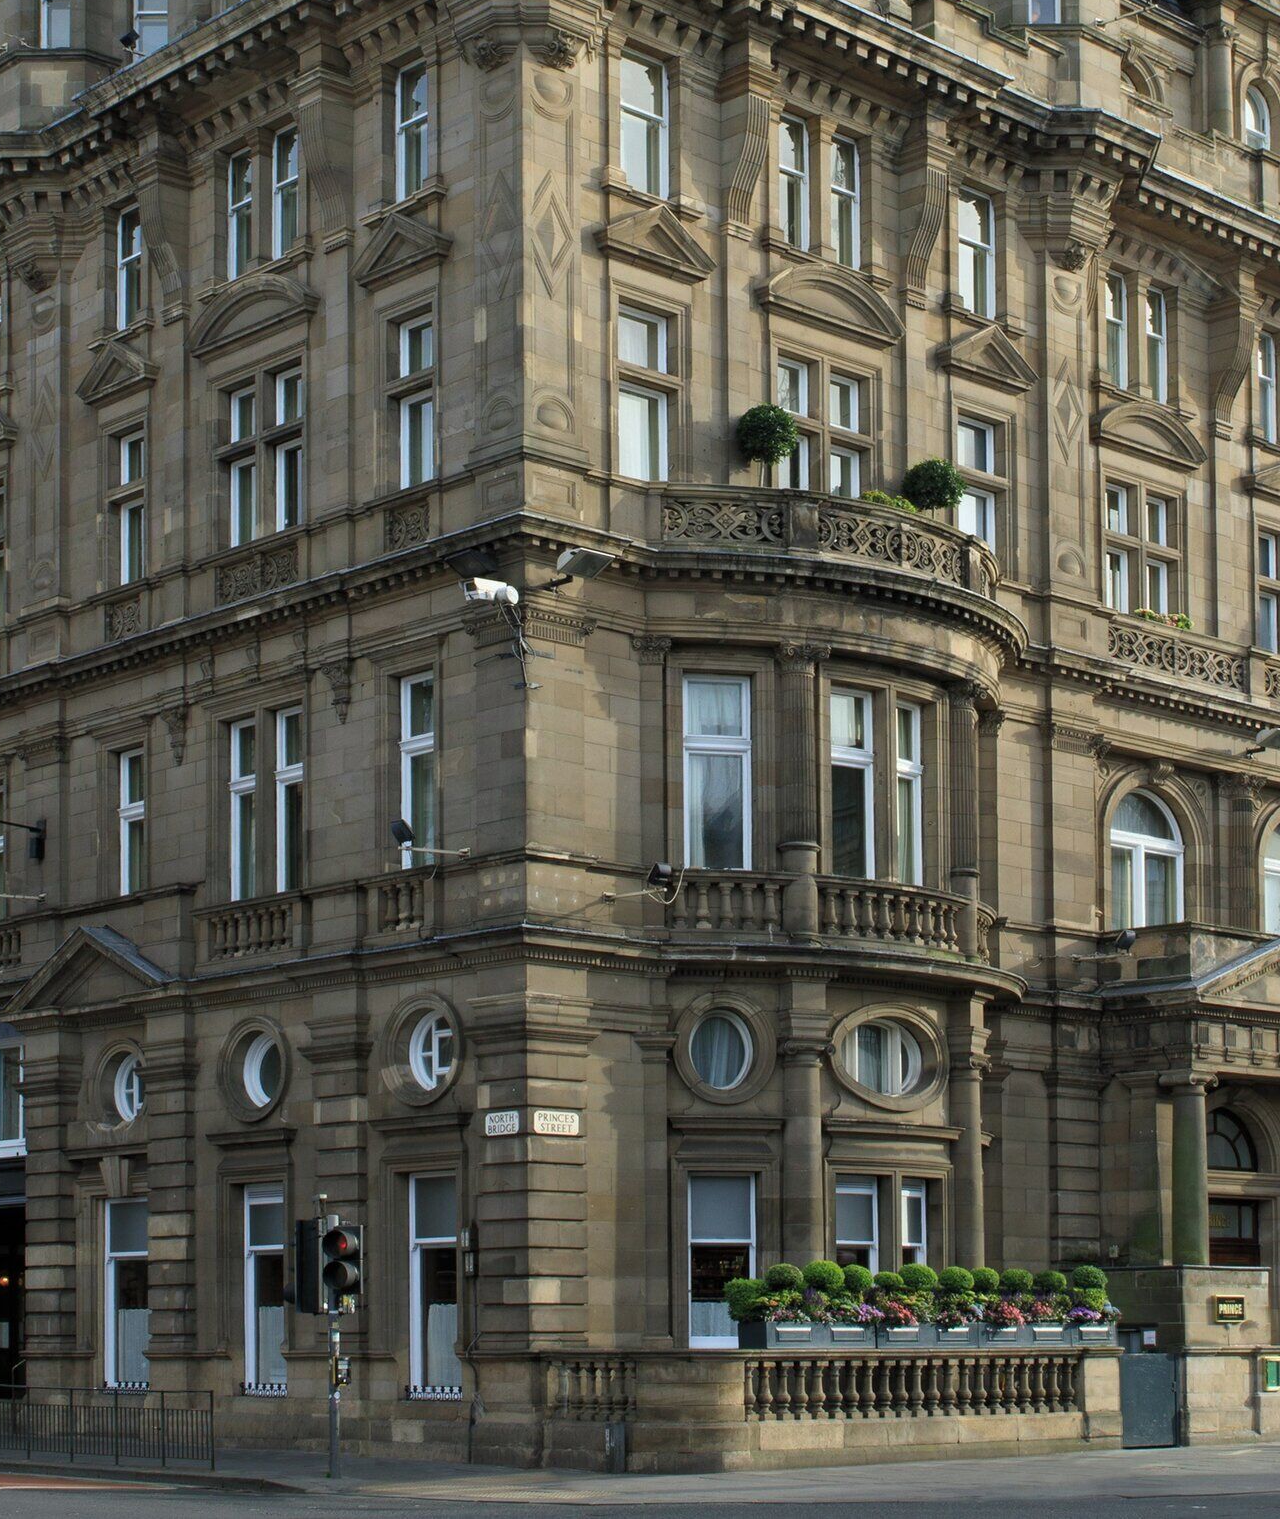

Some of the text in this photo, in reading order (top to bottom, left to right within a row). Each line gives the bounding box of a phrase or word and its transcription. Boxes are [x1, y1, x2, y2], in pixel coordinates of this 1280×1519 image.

[489, 1113, 515, 1124] NORTH
[538, 1113, 575, 1123] PRINCES
[488, 1123, 516, 1134] BRIDGE
[540, 1123, 573, 1133] STREET
[1218, 1303, 1242, 1314] PRINCE
